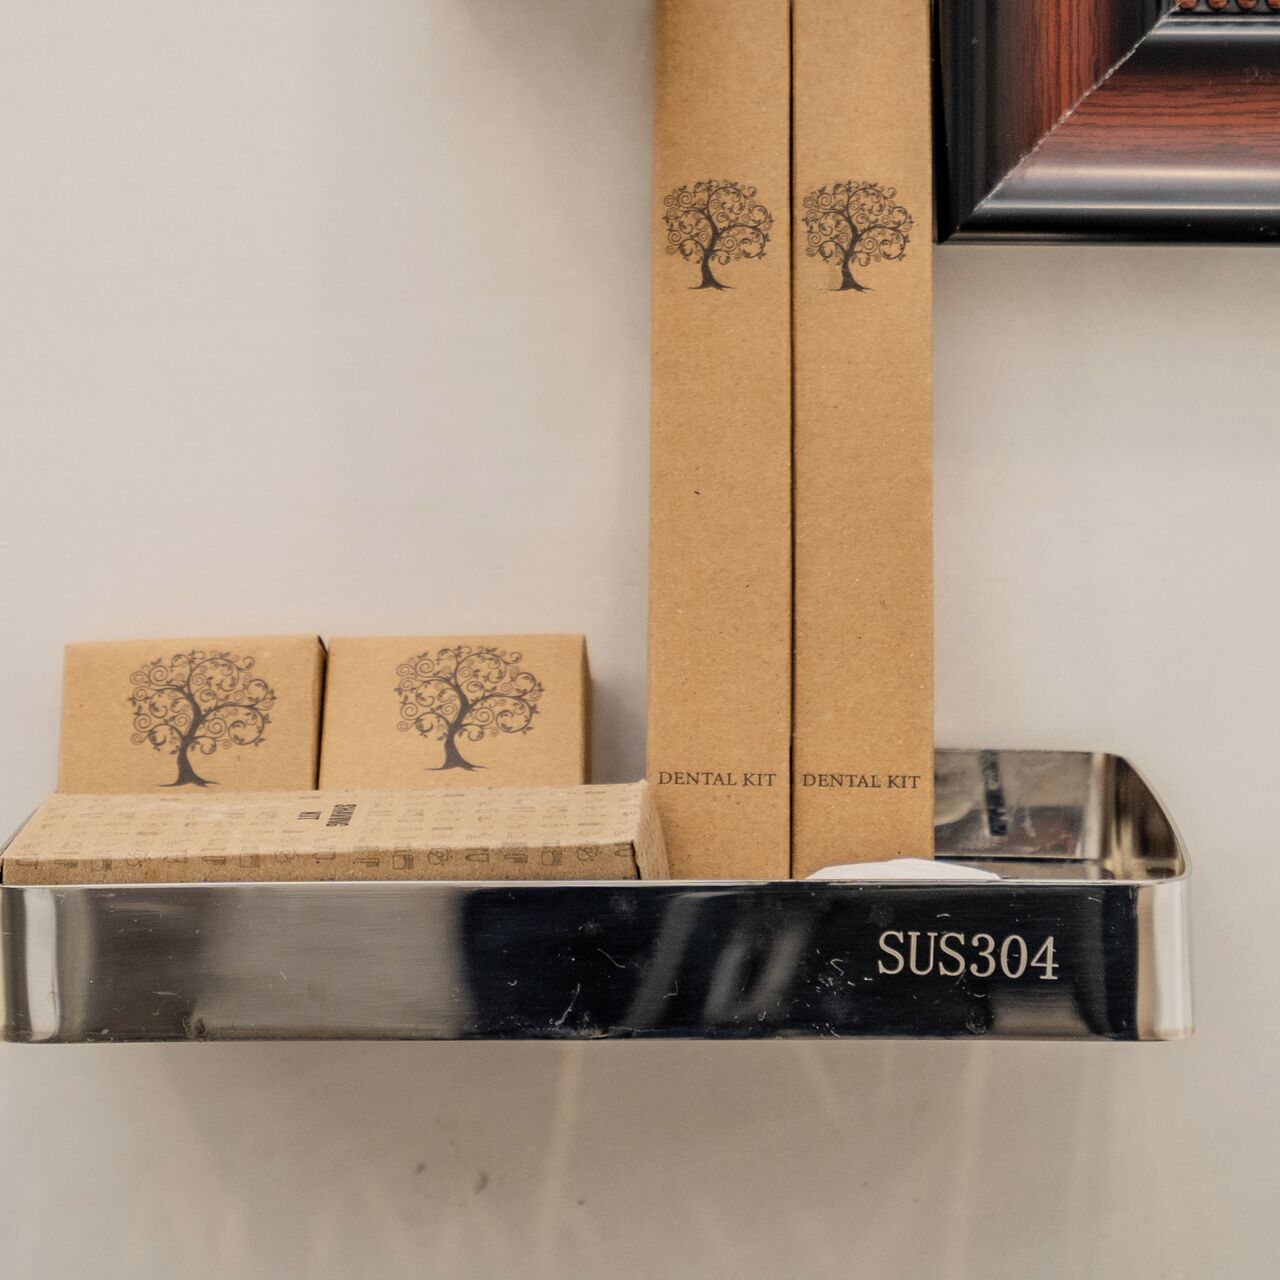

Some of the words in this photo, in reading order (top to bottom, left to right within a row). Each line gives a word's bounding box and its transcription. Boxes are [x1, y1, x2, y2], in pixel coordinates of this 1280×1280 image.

[658, 771, 737, 786] DENTAL
[742, 773, 777, 787] KIT
[802, 773, 881, 788] DENTAL
[887, 775, 921, 789] KIT
[877, 930, 1060, 980] SUS304
